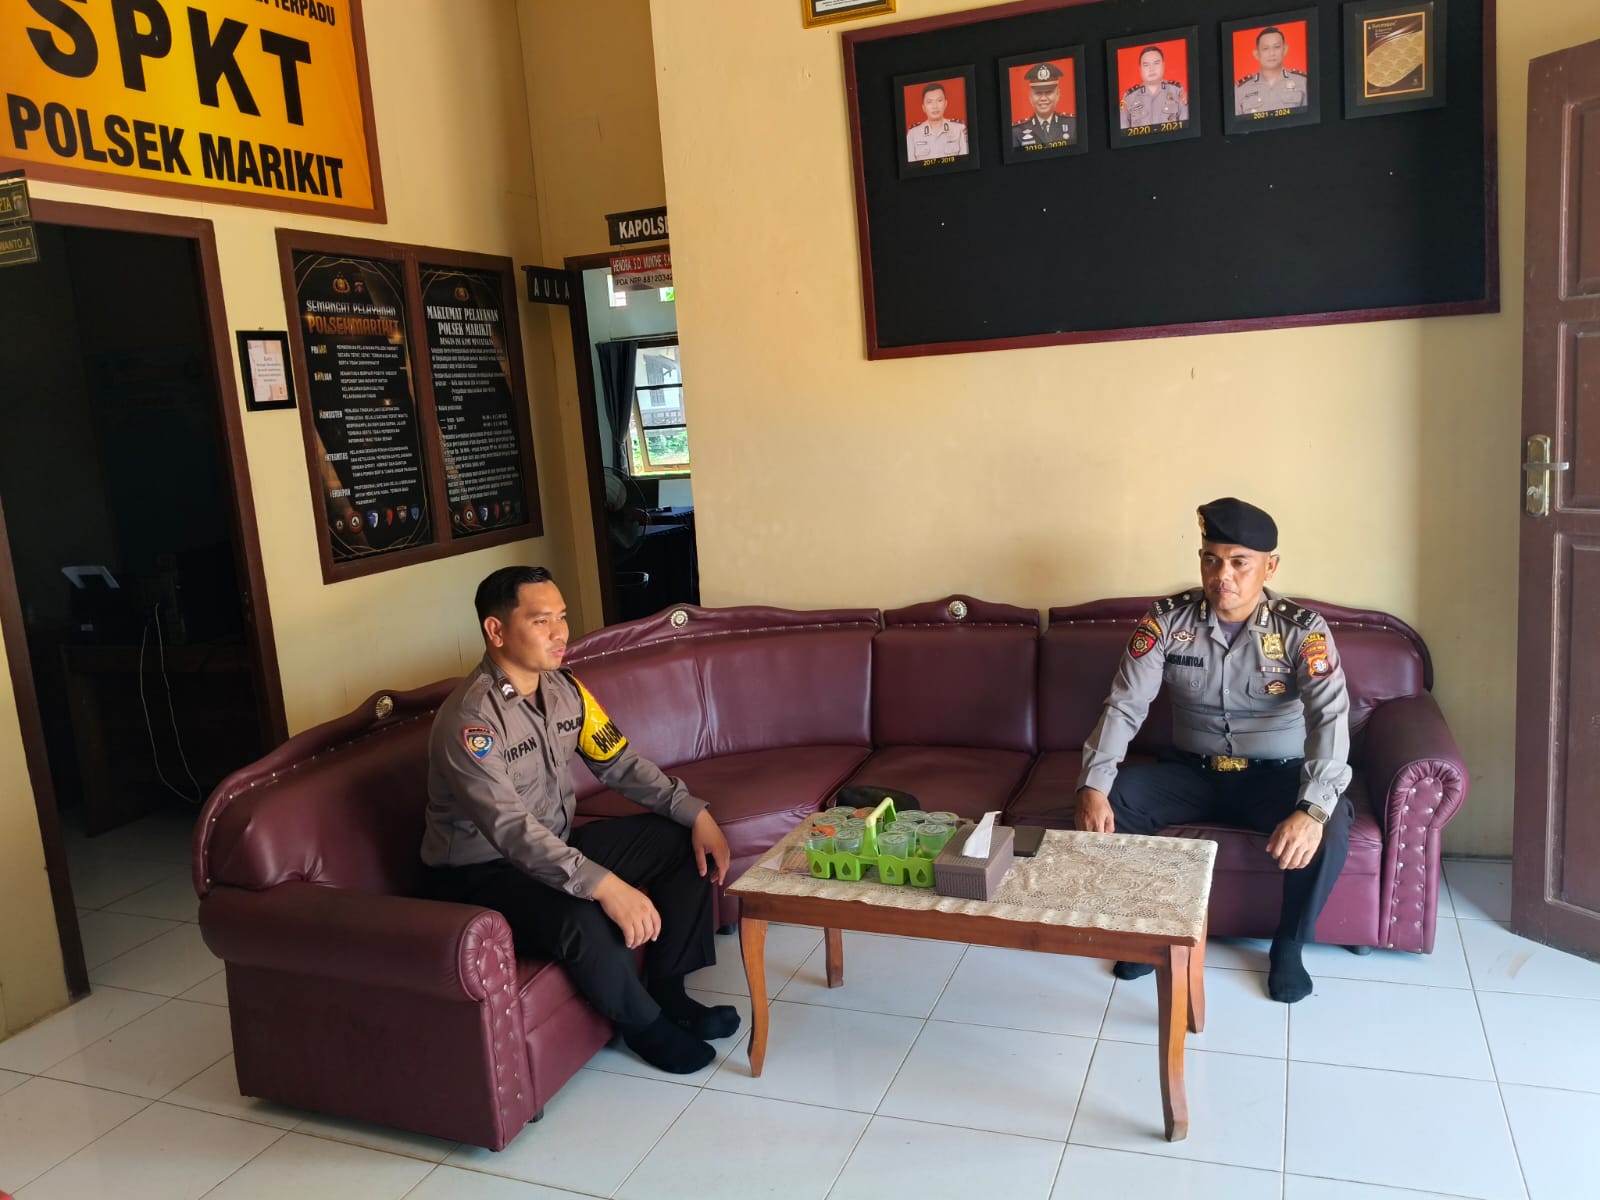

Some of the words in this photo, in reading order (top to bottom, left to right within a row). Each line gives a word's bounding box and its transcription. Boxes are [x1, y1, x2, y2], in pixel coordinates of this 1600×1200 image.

[25, 0, 313, 127] SPKT
[1127, 125, 1151, 137] 2020
[1160, 121, 1183, 132] 2021
[6, 93, 192, 176] POLSEK
[198, 132, 344, 199] MARIKIT
[534, 276, 571, 300] AULA
[426, 305, 463, 320] MAKLUMAT
[437, 321, 464, 336] POLSEK
